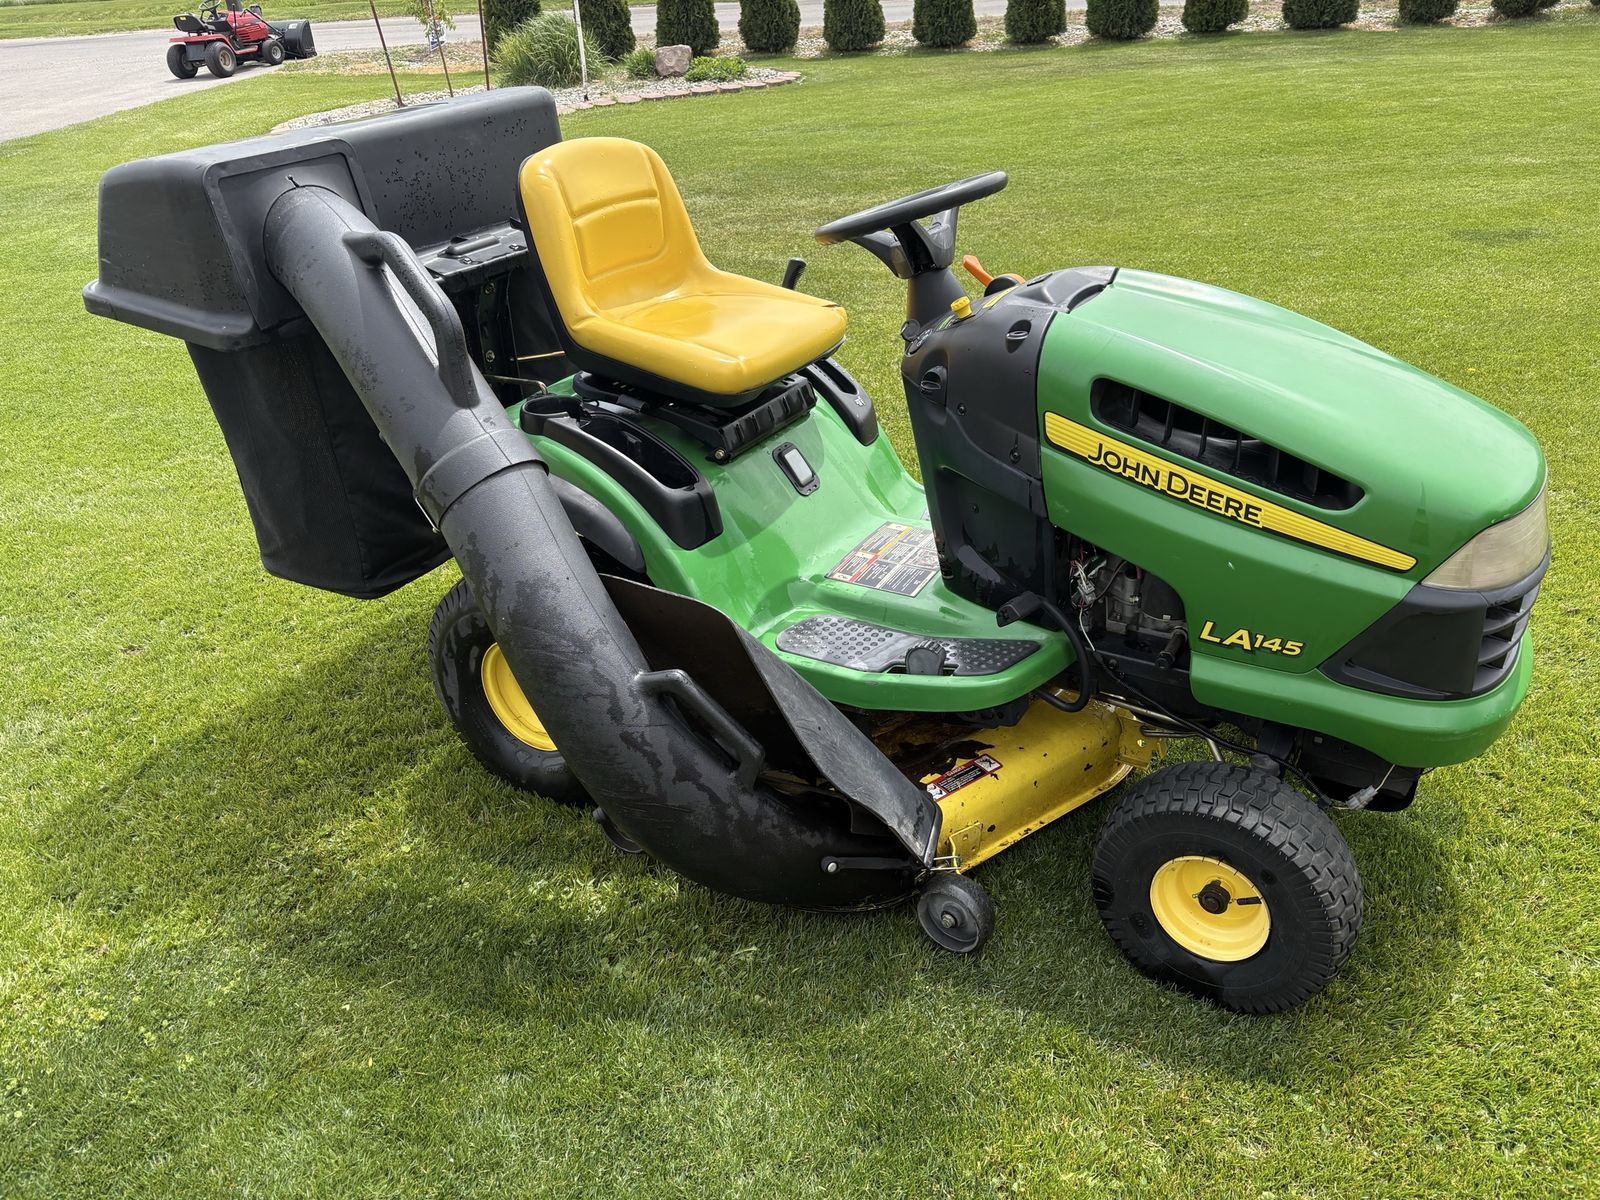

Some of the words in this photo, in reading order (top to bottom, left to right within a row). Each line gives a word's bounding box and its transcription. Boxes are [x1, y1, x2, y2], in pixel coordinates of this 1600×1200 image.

[1087, 443, 1161, 487] JOHN
[1166, 470, 1263, 525] DEERE
[1199, 620, 1304, 656] LA145
